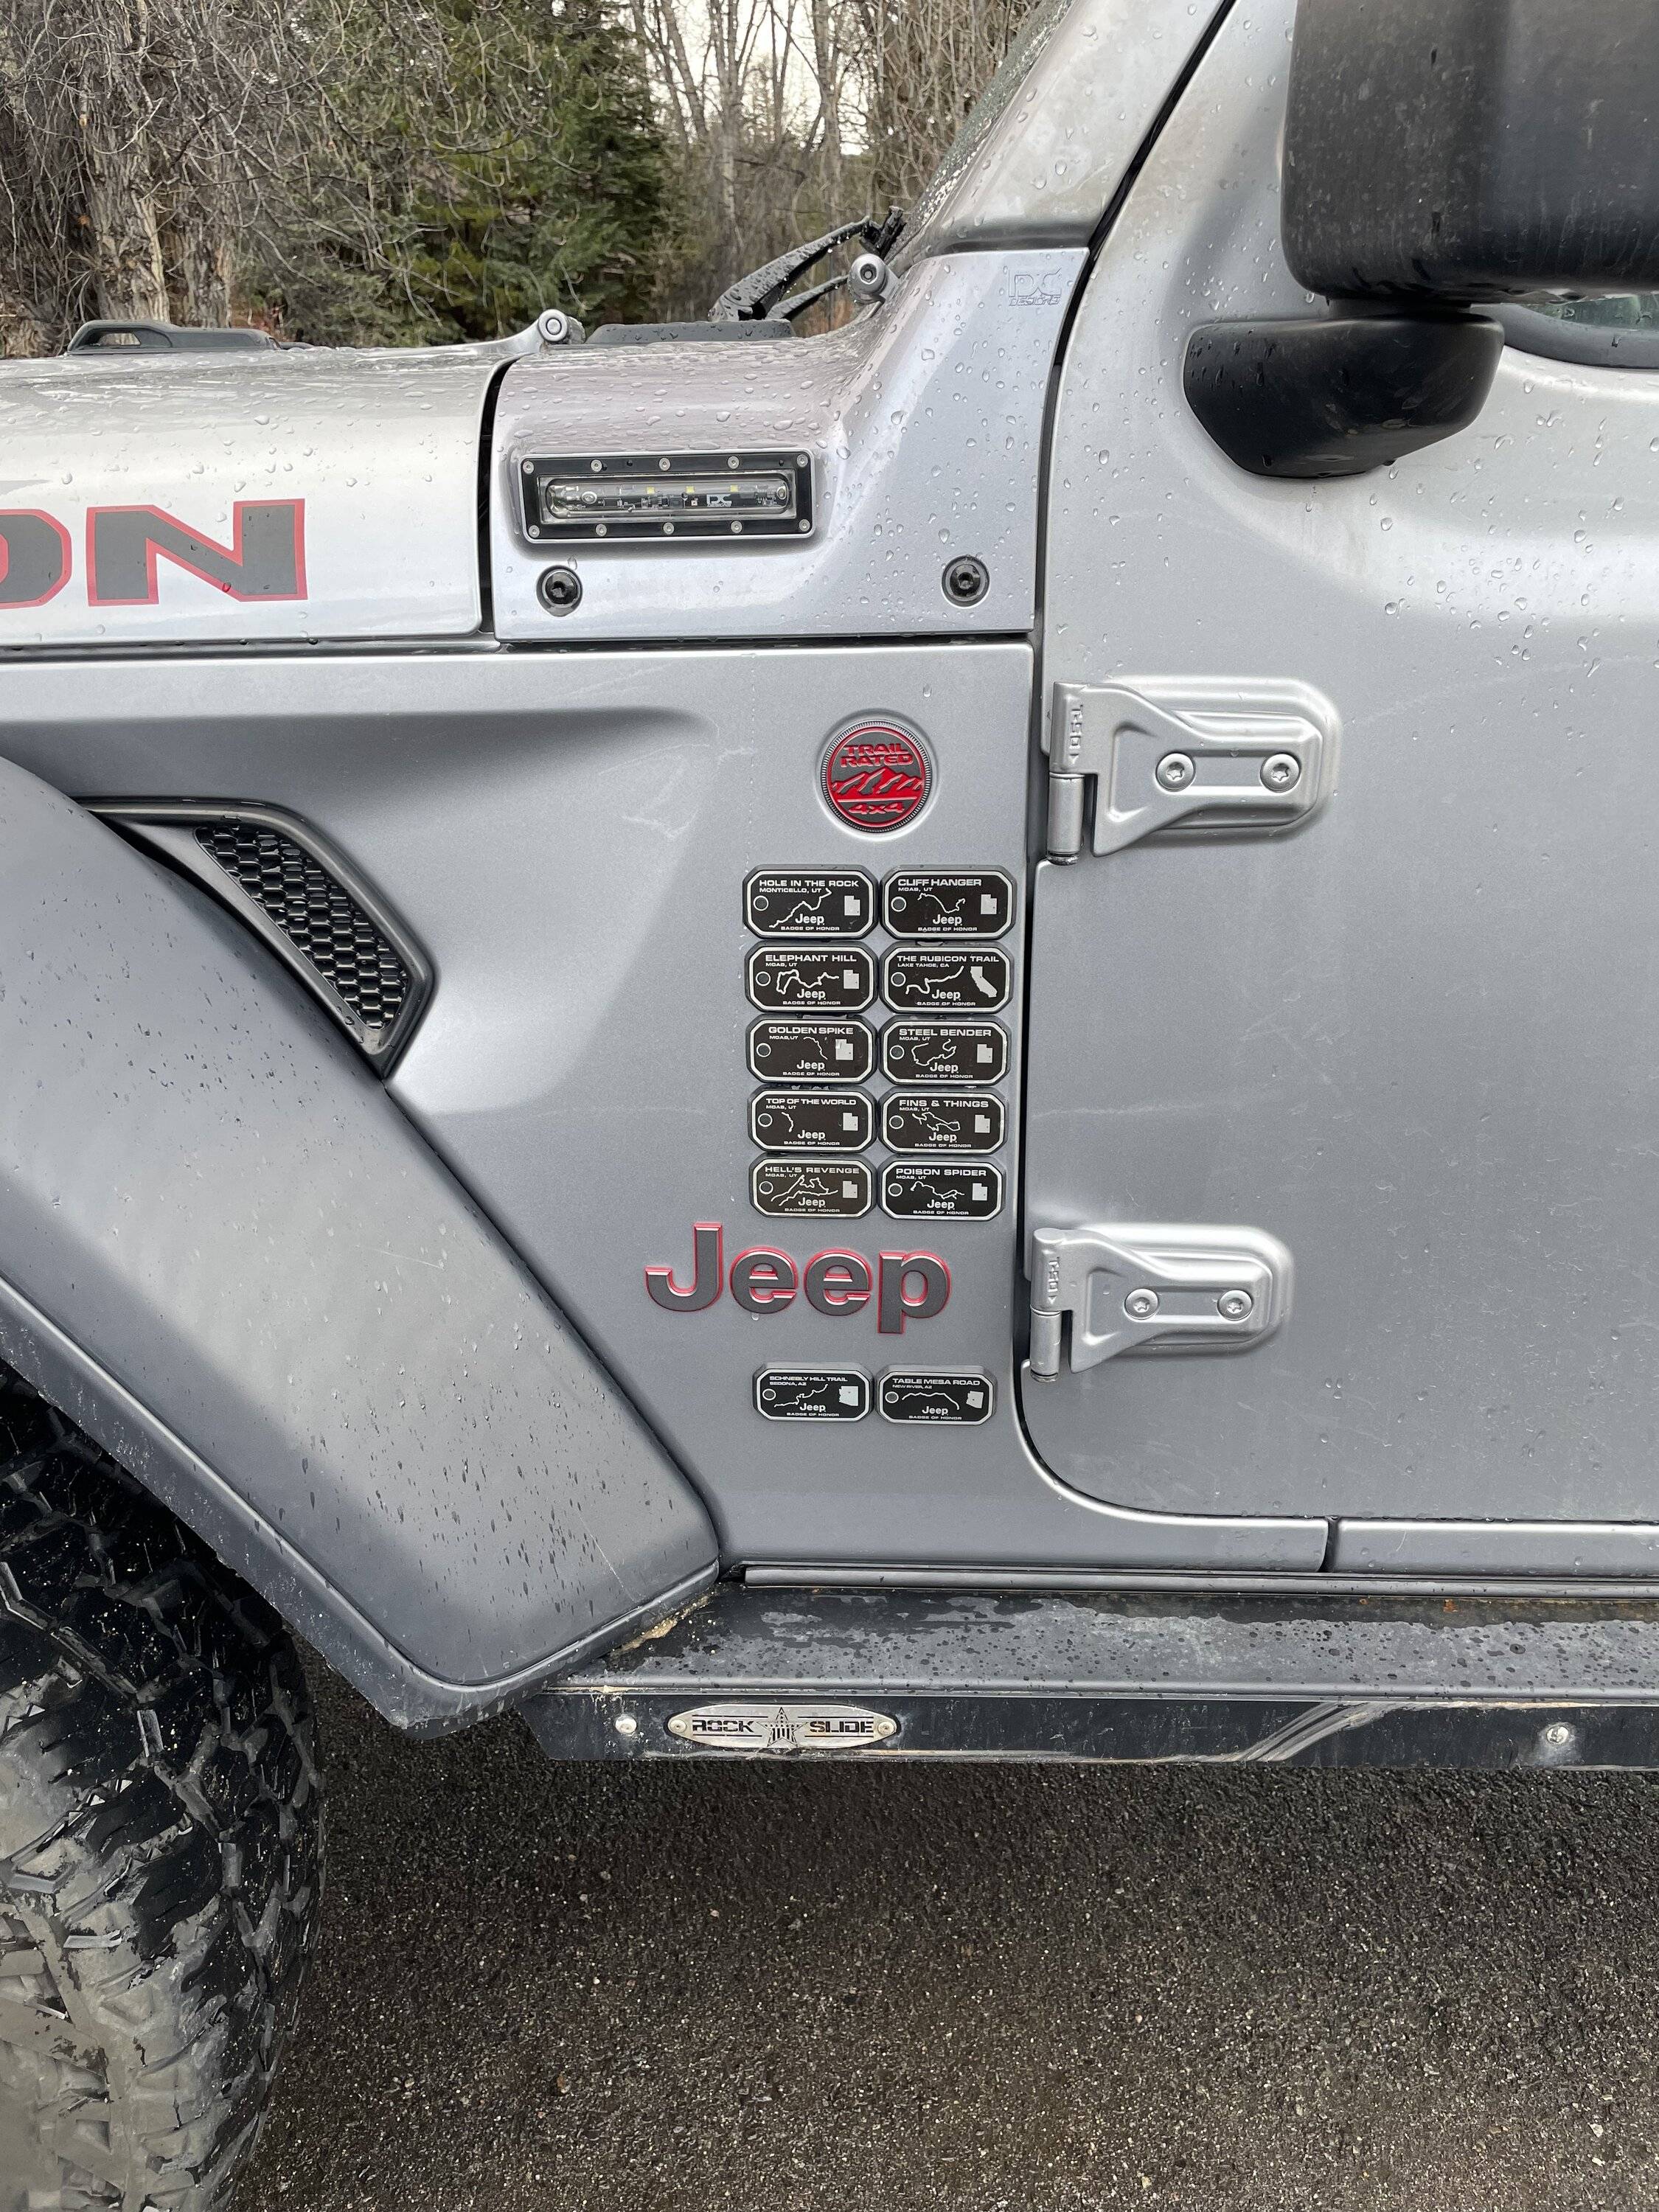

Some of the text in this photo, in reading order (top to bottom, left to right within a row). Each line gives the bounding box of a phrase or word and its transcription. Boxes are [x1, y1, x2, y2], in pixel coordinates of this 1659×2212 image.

[844, 743, 908, 756] TRAIL
[840, 754, 913, 768] RATED
[795, 914, 824, 925] Jeep
[933, 914, 962, 926] Jeep
[797, 989, 826, 1000] Jeep
[931, 990, 961, 1001] Jeep
[796, 1060, 825, 1071] Jeep
[930, 1062, 959, 1074] Jeep
[798, 1130, 826, 1141] Jeep
[929, 1133, 957, 1143] Jeep
[798, 1197, 826, 1208] Jeep
[927, 1200, 955, 1210] Jeep
[644, 1222, 951, 1335] Jeep
[800, 1403, 826, 1412] Jeep
[922, 1406, 948, 1416] Jeep
[692, 1719, 874, 1733] ROCK SLIDE
